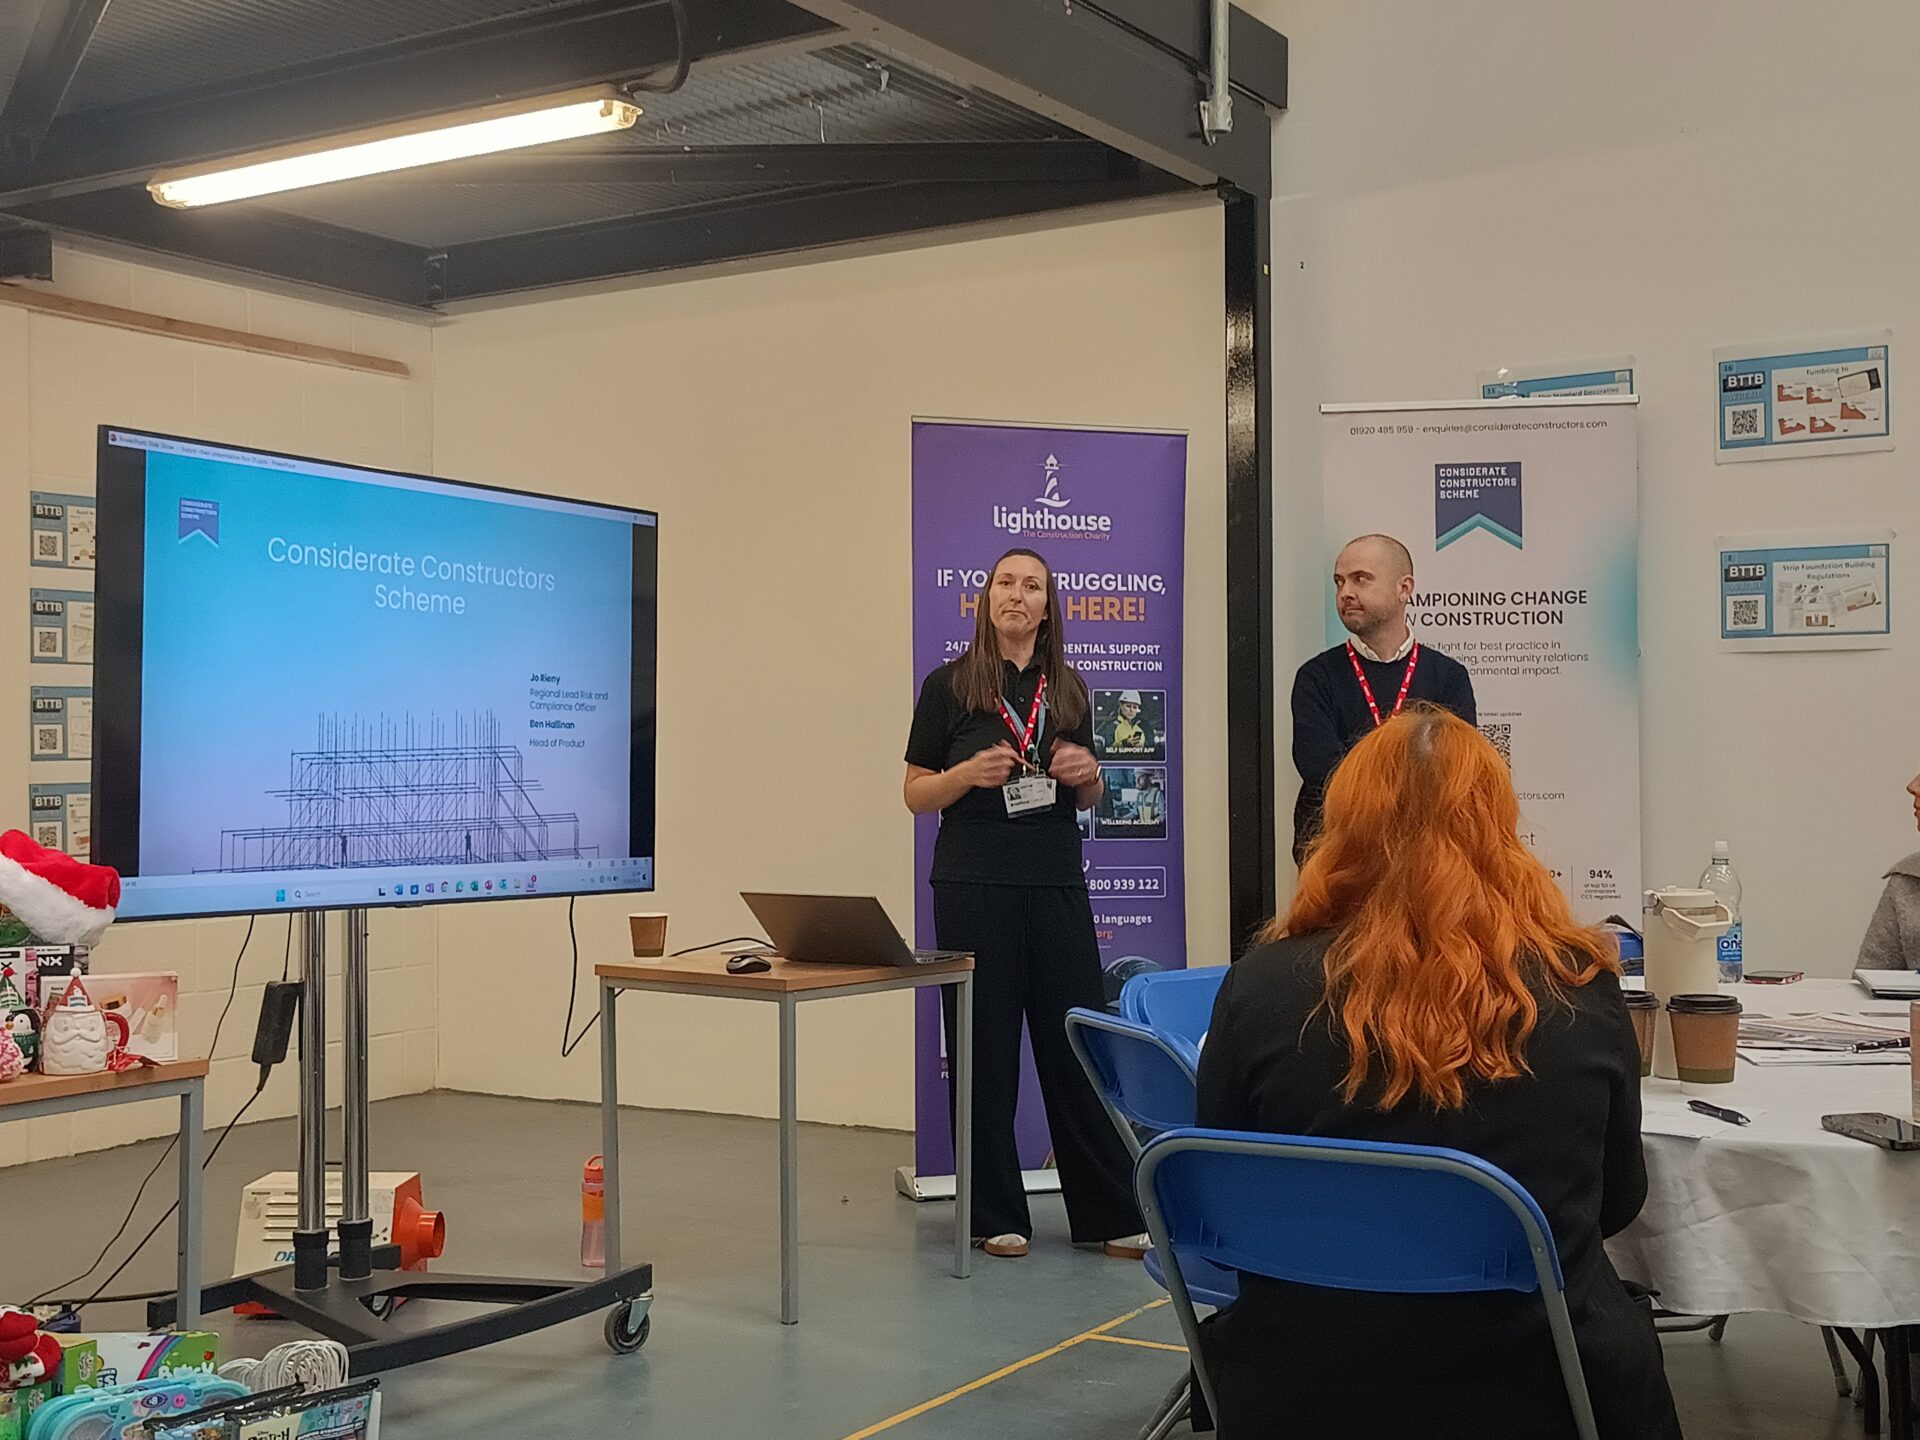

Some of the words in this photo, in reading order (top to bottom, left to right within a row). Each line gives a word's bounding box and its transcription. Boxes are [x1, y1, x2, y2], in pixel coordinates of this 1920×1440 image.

[1728, 373, 1764, 388] BTTB
[1350, 426, 1375, 435] 01920
[1440, 467, 1507, 477] CONSIDERATE
[1440, 478, 1517, 488] CONSTRUCTORS
[1440, 489, 1479, 499] SCHEME
[36, 504, 63, 517] BTTB
[993, 505, 1112, 534] lighthouse
[1037, 530, 1083, 539] Construction
[1084, 532, 1111, 541] Charity
[267, 537, 415, 576] Considerate
[421, 555, 555, 591] Constructors
[1801, 562, 1843, 570] Foundation
[1845, 561, 1876, 569] Building
[1729, 565, 1765, 578] BTTB
[1807, 573, 1850, 581] Regulations
[937, 569, 954, 587] IF
[1052, 572, 1167, 595] RUGGLING,
[375, 584, 466, 615] Scheme
[1407, 591, 1507, 607] AMPIONING
[1511, 590, 1587, 605] CHANGE
[35, 601, 63, 613] BTTB
[1067, 596, 1146, 622] HERE!
[1420, 610, 1563, 627] CONSTRUCTION
[945, 641, 970, 653] 24/7
[1109, 644, 1160, 655] SUPPORT
[1438, 641, 1460, 653] fight
[1463, 641, 1477, 650] for
[1480, 641, 1503, 650] best
[1505, 641, 1549, 653] practice
[1551, 640, 1561, 649] in
[1481, 654, 1541, 665] community
[1543, 652, 1589, 662] relations
[1077, 660, 1163, 671] CONSTRUCTION
[1469, 666, 1520, 676] onmental
[530, 673, 539, 682] Jo
[530, 688, 560, 700] Regional
[562, 690, 579, 699] Lead
[580, 690, 593, 699] Risk
[594, 691, 609, 700] and
[36, 698, 63, 710] BTTB
[529, 701, 573, 712] Compliance
[574, 702, 597, 712] Officer
[530, 719, 544, 728] Ben
[529, 738, 549, 747] Head
[550, 738, 557, 747] of
[558, 739, 585, 748] Product
[34, 795, 62, 807] BTTB
[1517, 792, 1565, 800] ctors.com
[1589, 869, 1613, 879] 94%
[1085, 879, 1111, 890] 800
[1113, 878, 1135, 890] 939
[1138, 879, 1159, 890] 122
[1102, 914, 1152, 926] languages
[37, 956, 63, 967] NX
